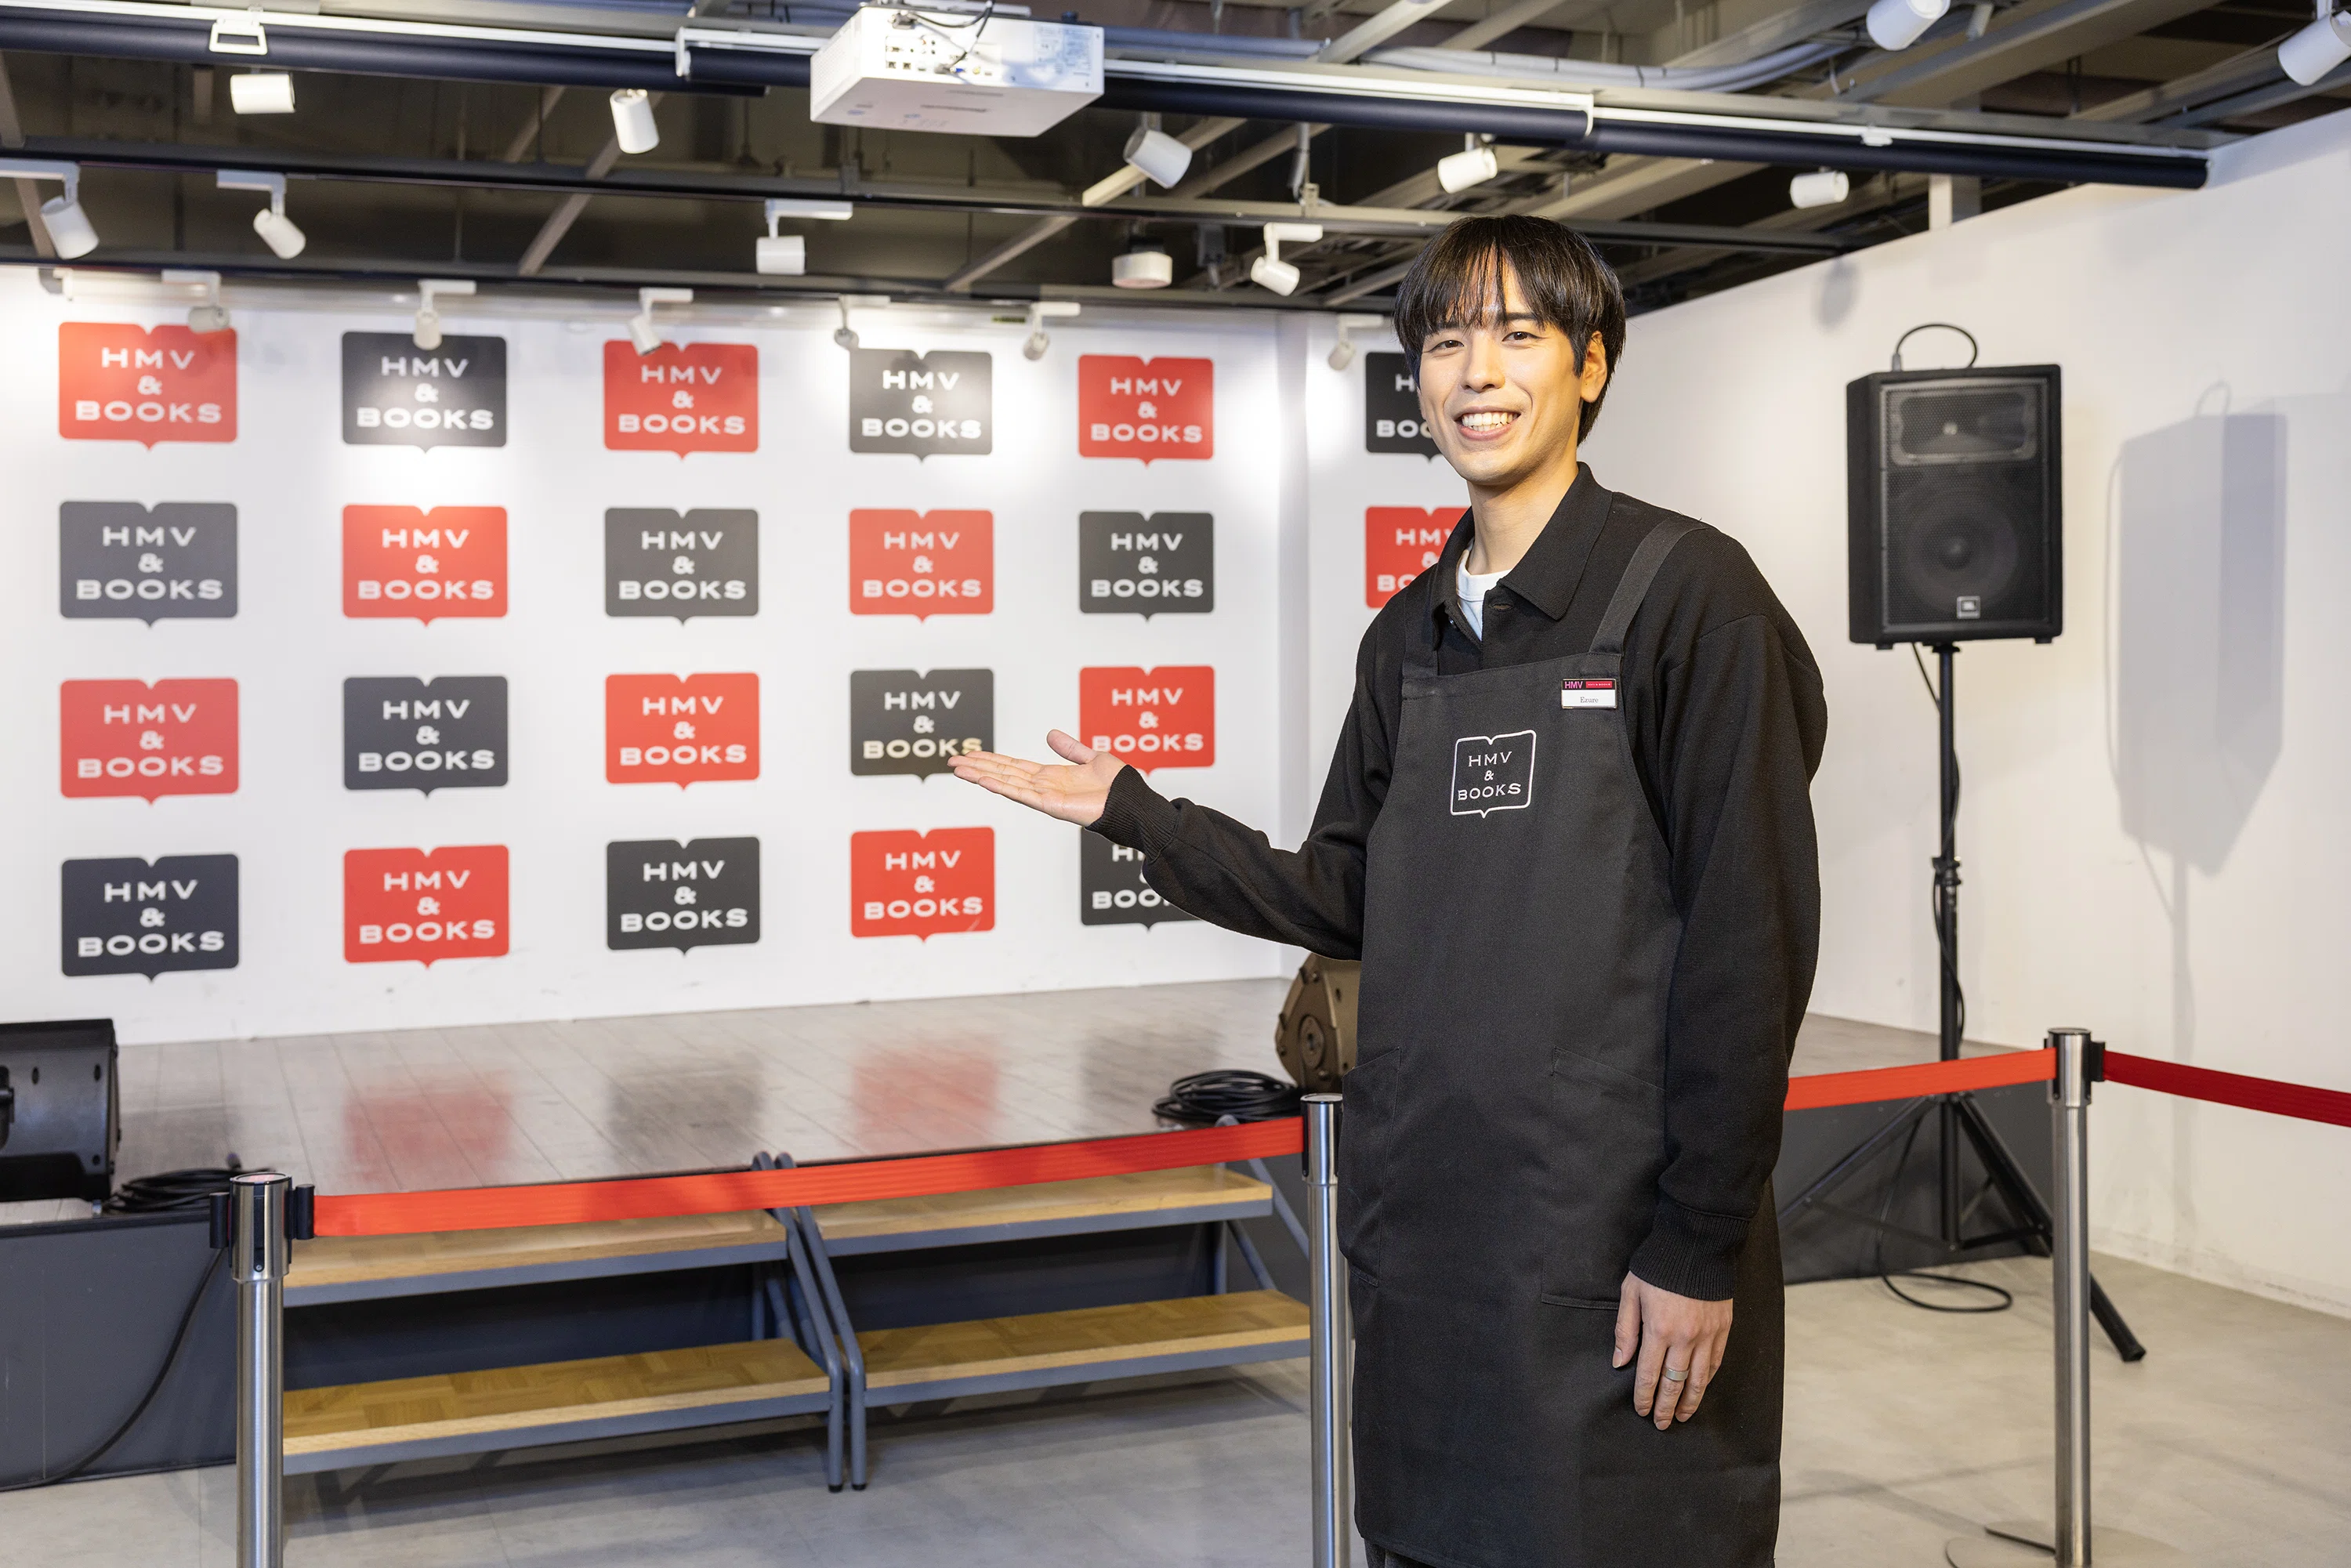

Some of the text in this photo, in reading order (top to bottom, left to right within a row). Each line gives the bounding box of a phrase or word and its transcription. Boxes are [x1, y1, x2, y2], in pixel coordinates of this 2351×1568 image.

[101, 347, 194, 369] HMV
[381, 357, 469, 378] HMV
[641, 364, 722, 385] HMV
[882, 370, 959, 390] HMV
[137, 375, 162, 396] &
[415, 383, 439, 403] &
[1110, 377, 1182, 397] HMV
[672, 390, 694, 409] &
[911, 395, 933, 414] &
[1138, 401, 1157, 419] &
[75, 400, 222, 423] BOOKS
[357, 407, 494, 430] BOOKS
[618, 414, 746, 435] BOOKS
[862, 418, 981, 439] BOOKS
[1090, 423, 1203, 444] BOOKS
[103, 526, 196, 547] HMV
[382, 528, 469, 549] HMV
[641, 531, 723, 550] HMV
[883, 531, 960, 550] HMV
[1110, 532, 1183, 552] HMV
[138, 552, 164, 573] &
[415, 554, 440, 574] &
[672, 556, 695, 575] &
[912, 555, 933, 574] &
[1138, 556, 1158, 574] &
[76, 578, 223, 600] BOOKS
[357, 579, 494, 600] BOOKS
[618, 580, 746, 600] BOOKS
[862, 578, 982, 598] BOOKS
[1091, 578, 1204, 598] BOOKS
[642, 696, 724, 716] HMV
[884, 690, 961, 711] HMV
[1111, 687, 1183, 706] HMV
[103, 703, 197, 725] HMV
[382, 699, 470, 720] HMV
[1139, 711, 1158, 729] &
[673, 721, 696, 740] &
[913, 715, 935, 733] &
[139, 730, 165, 751] &
[415, 725, 440, 745] &
[1092, 733, 1204, 753] BOOKS
[620, 744, 747, 766] BOOKS
[863, 738, 982, 759] BOOKS
[1468, 751, 1512, 767] HMV
[78, 755, 224, 778] BOOKS
[358, 749, 495, 772] BOOKS
[1483, 770, 1494, 781] &
[1458, 783, 1521, 801] BOOKS
[643, 860, 725, 882] HMV
[885, 850, 962, 871] HMV
[104, 879, 197, 903] HMV
[383, 870, 470, 892] HMV
[914, 875, 935, 893] &
[674, 885, 697, 905] &
[1092, 889, 1171, 909] BOO
[416, 896, 440, 916] &
[864, 899, 983, 920] BOOKS
[139, 907, 165, 928] &
[621, 910, 748, 932] BOOKS
[359, 921, 495, 944] BOOKS
[78, 930, 225, 958] BOOKS
